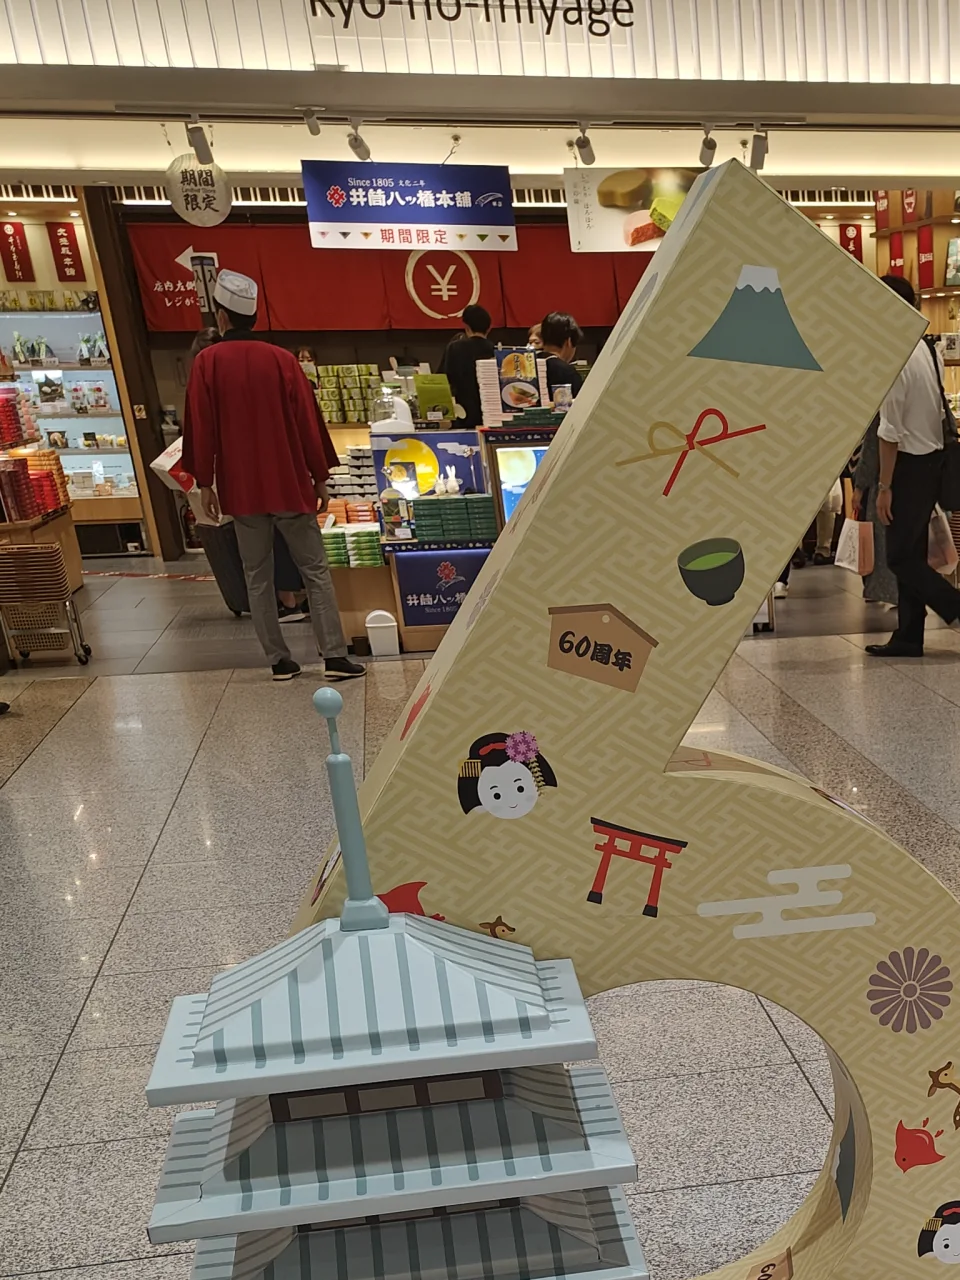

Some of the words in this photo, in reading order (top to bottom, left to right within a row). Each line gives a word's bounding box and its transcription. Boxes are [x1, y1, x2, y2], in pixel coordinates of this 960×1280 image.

[180, 169, 215, 187] 期間
[348, 178, 370, 186] Since
[372, 178, 394, 187] 1805
[183, 194, 219, 212] 限定
[380, 228, 449, 245] 期間限定
[558, 630, 633, 672] 60周年
